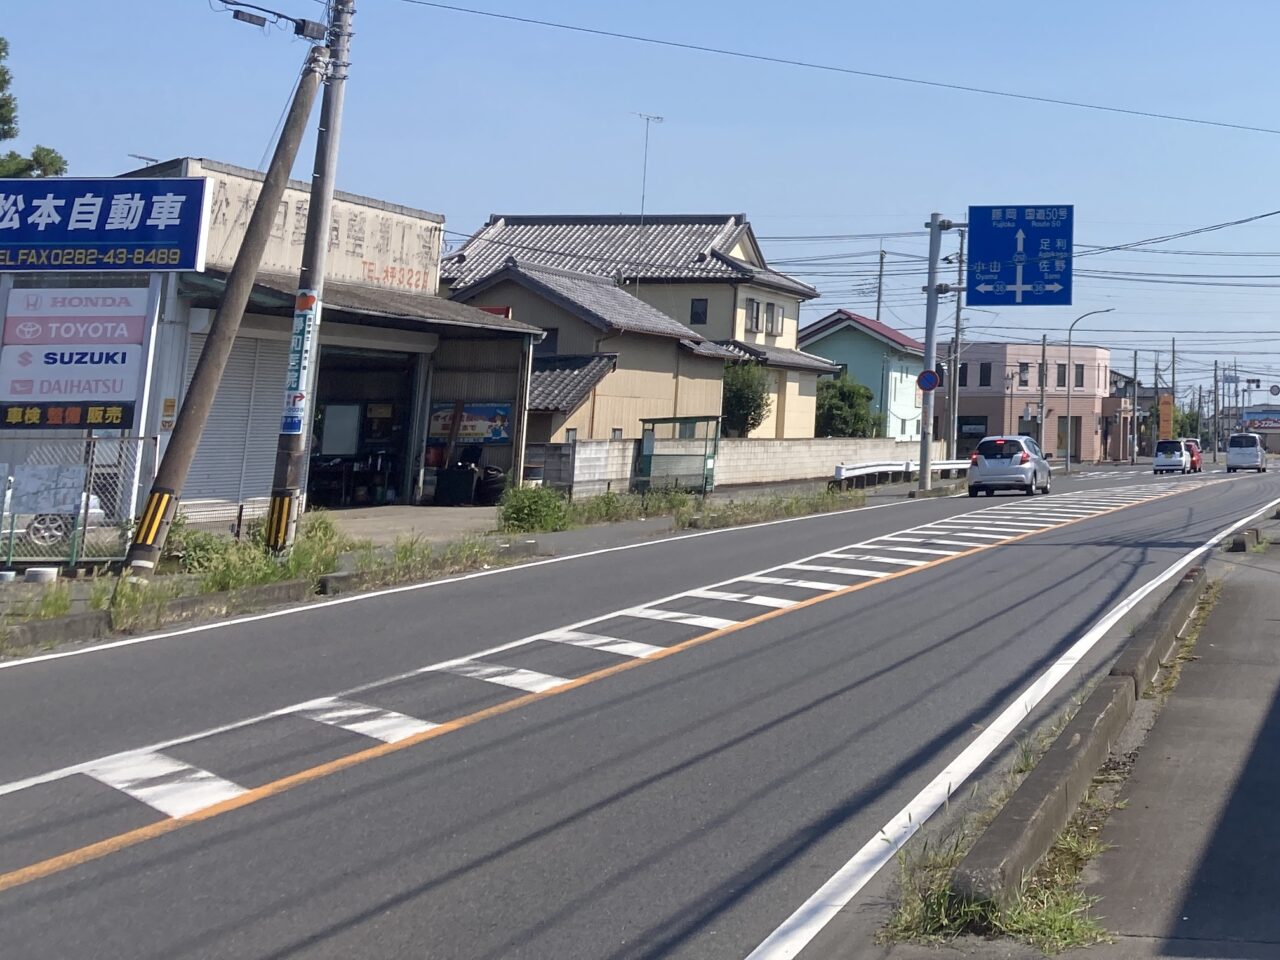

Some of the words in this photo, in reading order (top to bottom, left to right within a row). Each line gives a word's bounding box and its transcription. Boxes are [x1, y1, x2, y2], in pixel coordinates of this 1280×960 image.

[0, 192, 187, 231] 松本自動車
[50, 296, 133, 308] HONDA
[48, 323, 128, 338] TOYOTA
[44, 352, 127, 365] SUZUKI
[40, 379, 124, 394] DAIHATSU
